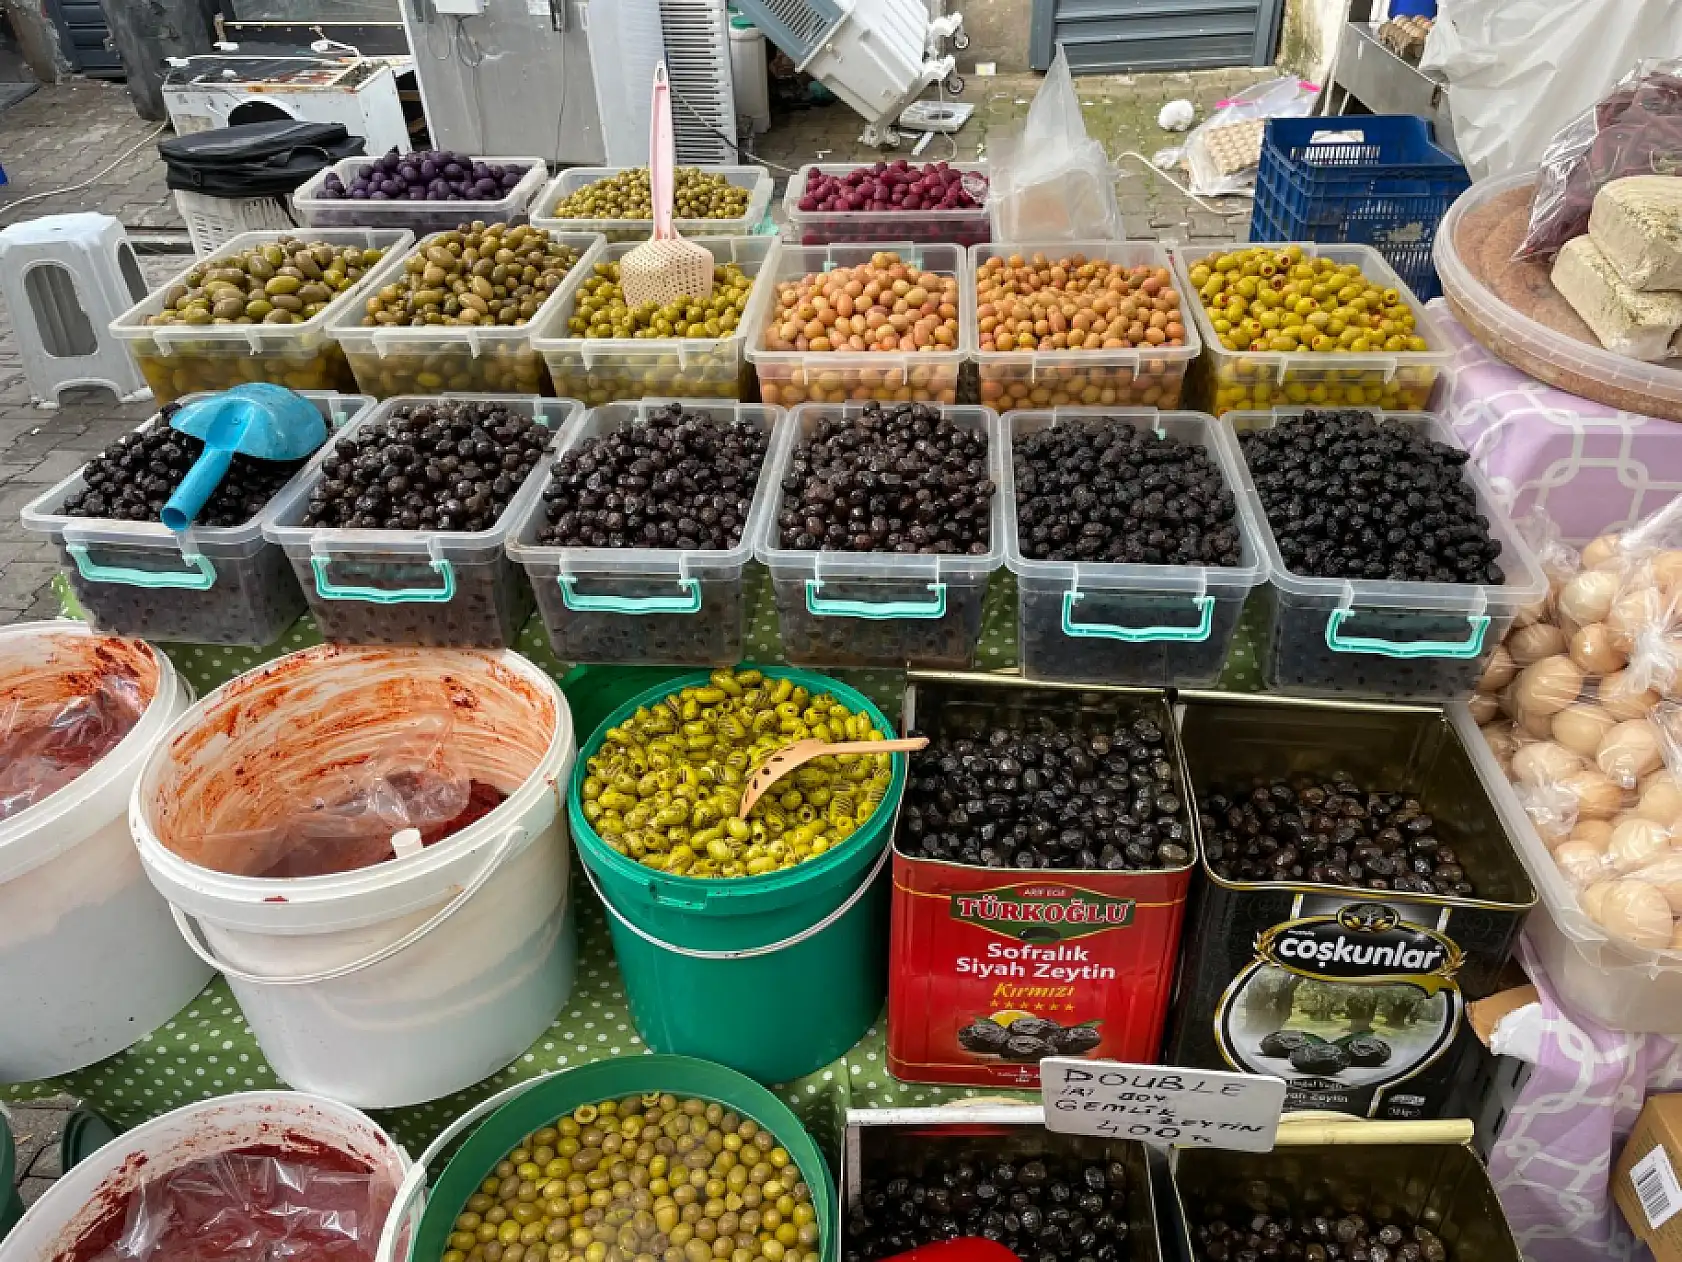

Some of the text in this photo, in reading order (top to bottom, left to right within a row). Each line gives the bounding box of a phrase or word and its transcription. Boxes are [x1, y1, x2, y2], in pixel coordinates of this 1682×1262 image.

[957, 895, 1130, 924] TÜRKOĞLU
[987, 943, 1089, 962] Sofralık
[1279, 936, 1441, 969] coşkunlar
[956, 957, 1116, 983] Siyah Zeytin
[993, 983, 1075, 998] Kırmızı
[1064, 1068, 1248, 1097] DOUBLE
[1097, 1119, 1181, 1139] 400
